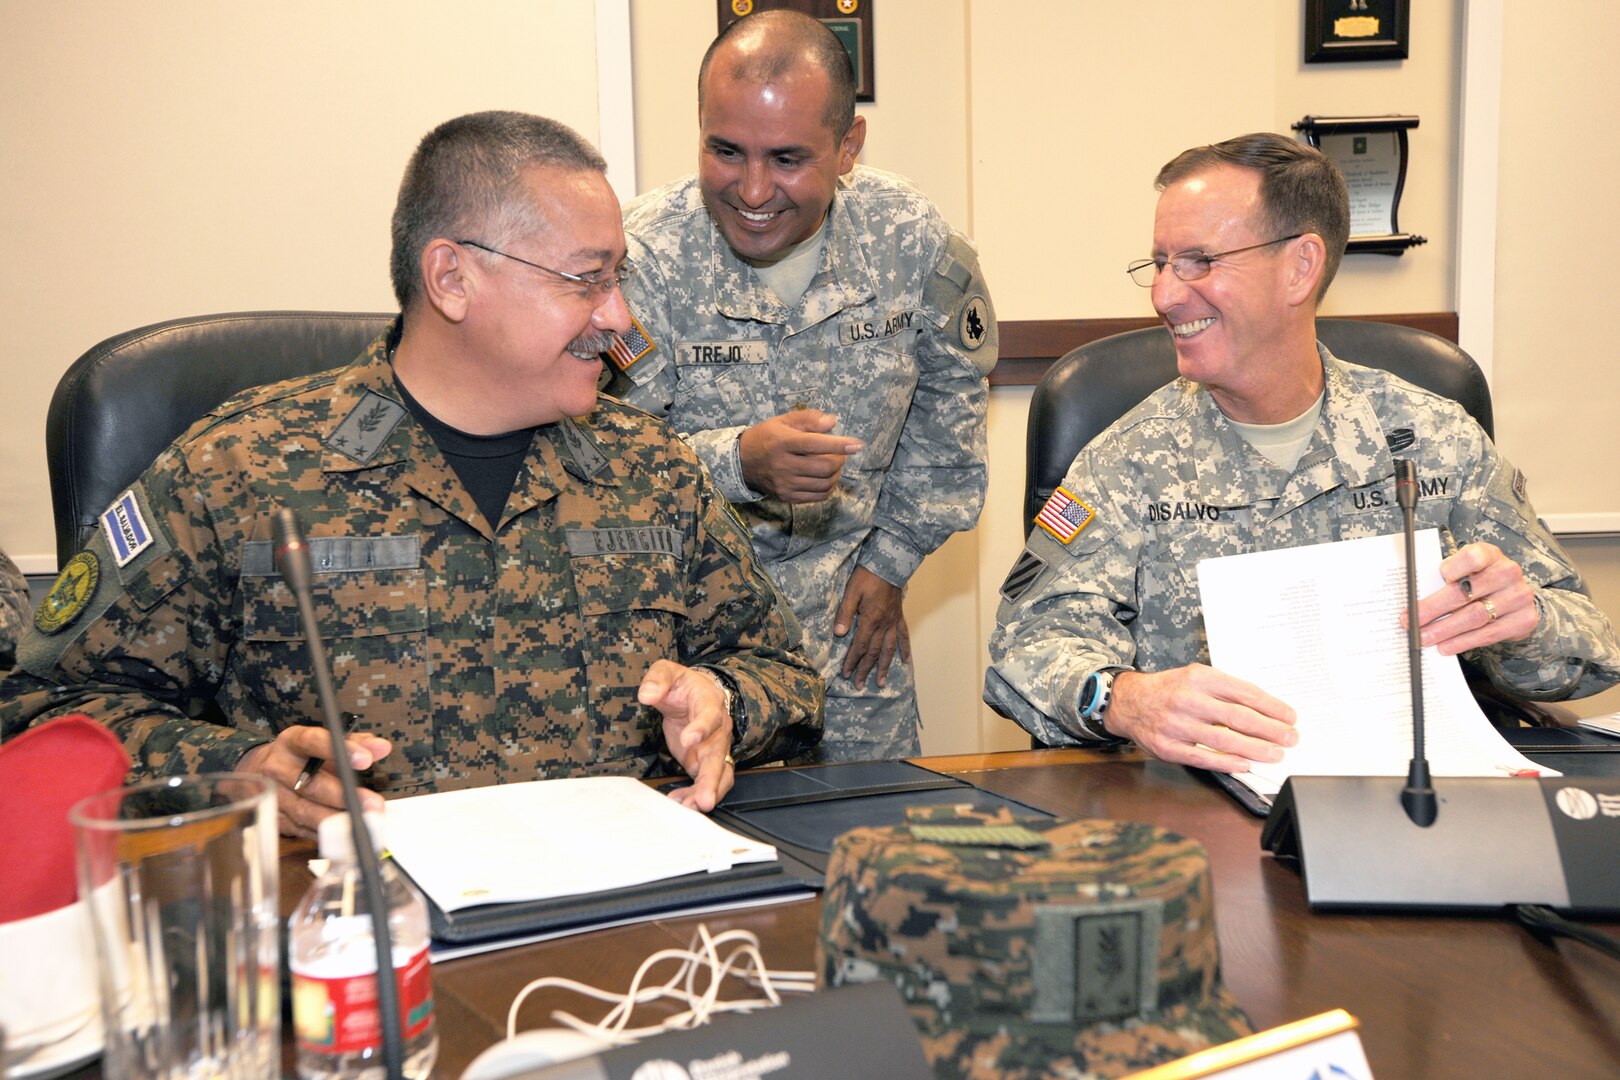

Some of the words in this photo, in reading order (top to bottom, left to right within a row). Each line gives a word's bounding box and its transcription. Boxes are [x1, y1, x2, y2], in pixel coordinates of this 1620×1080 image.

[850, 322, 879, 341] U.S.
[884, 311, 914, 337] ARMY
[691, 345, 742, 364] TREJO
[1353, 490, 1389, 510] U.S.
[1148, 501, 1220, 522] DISALVO
